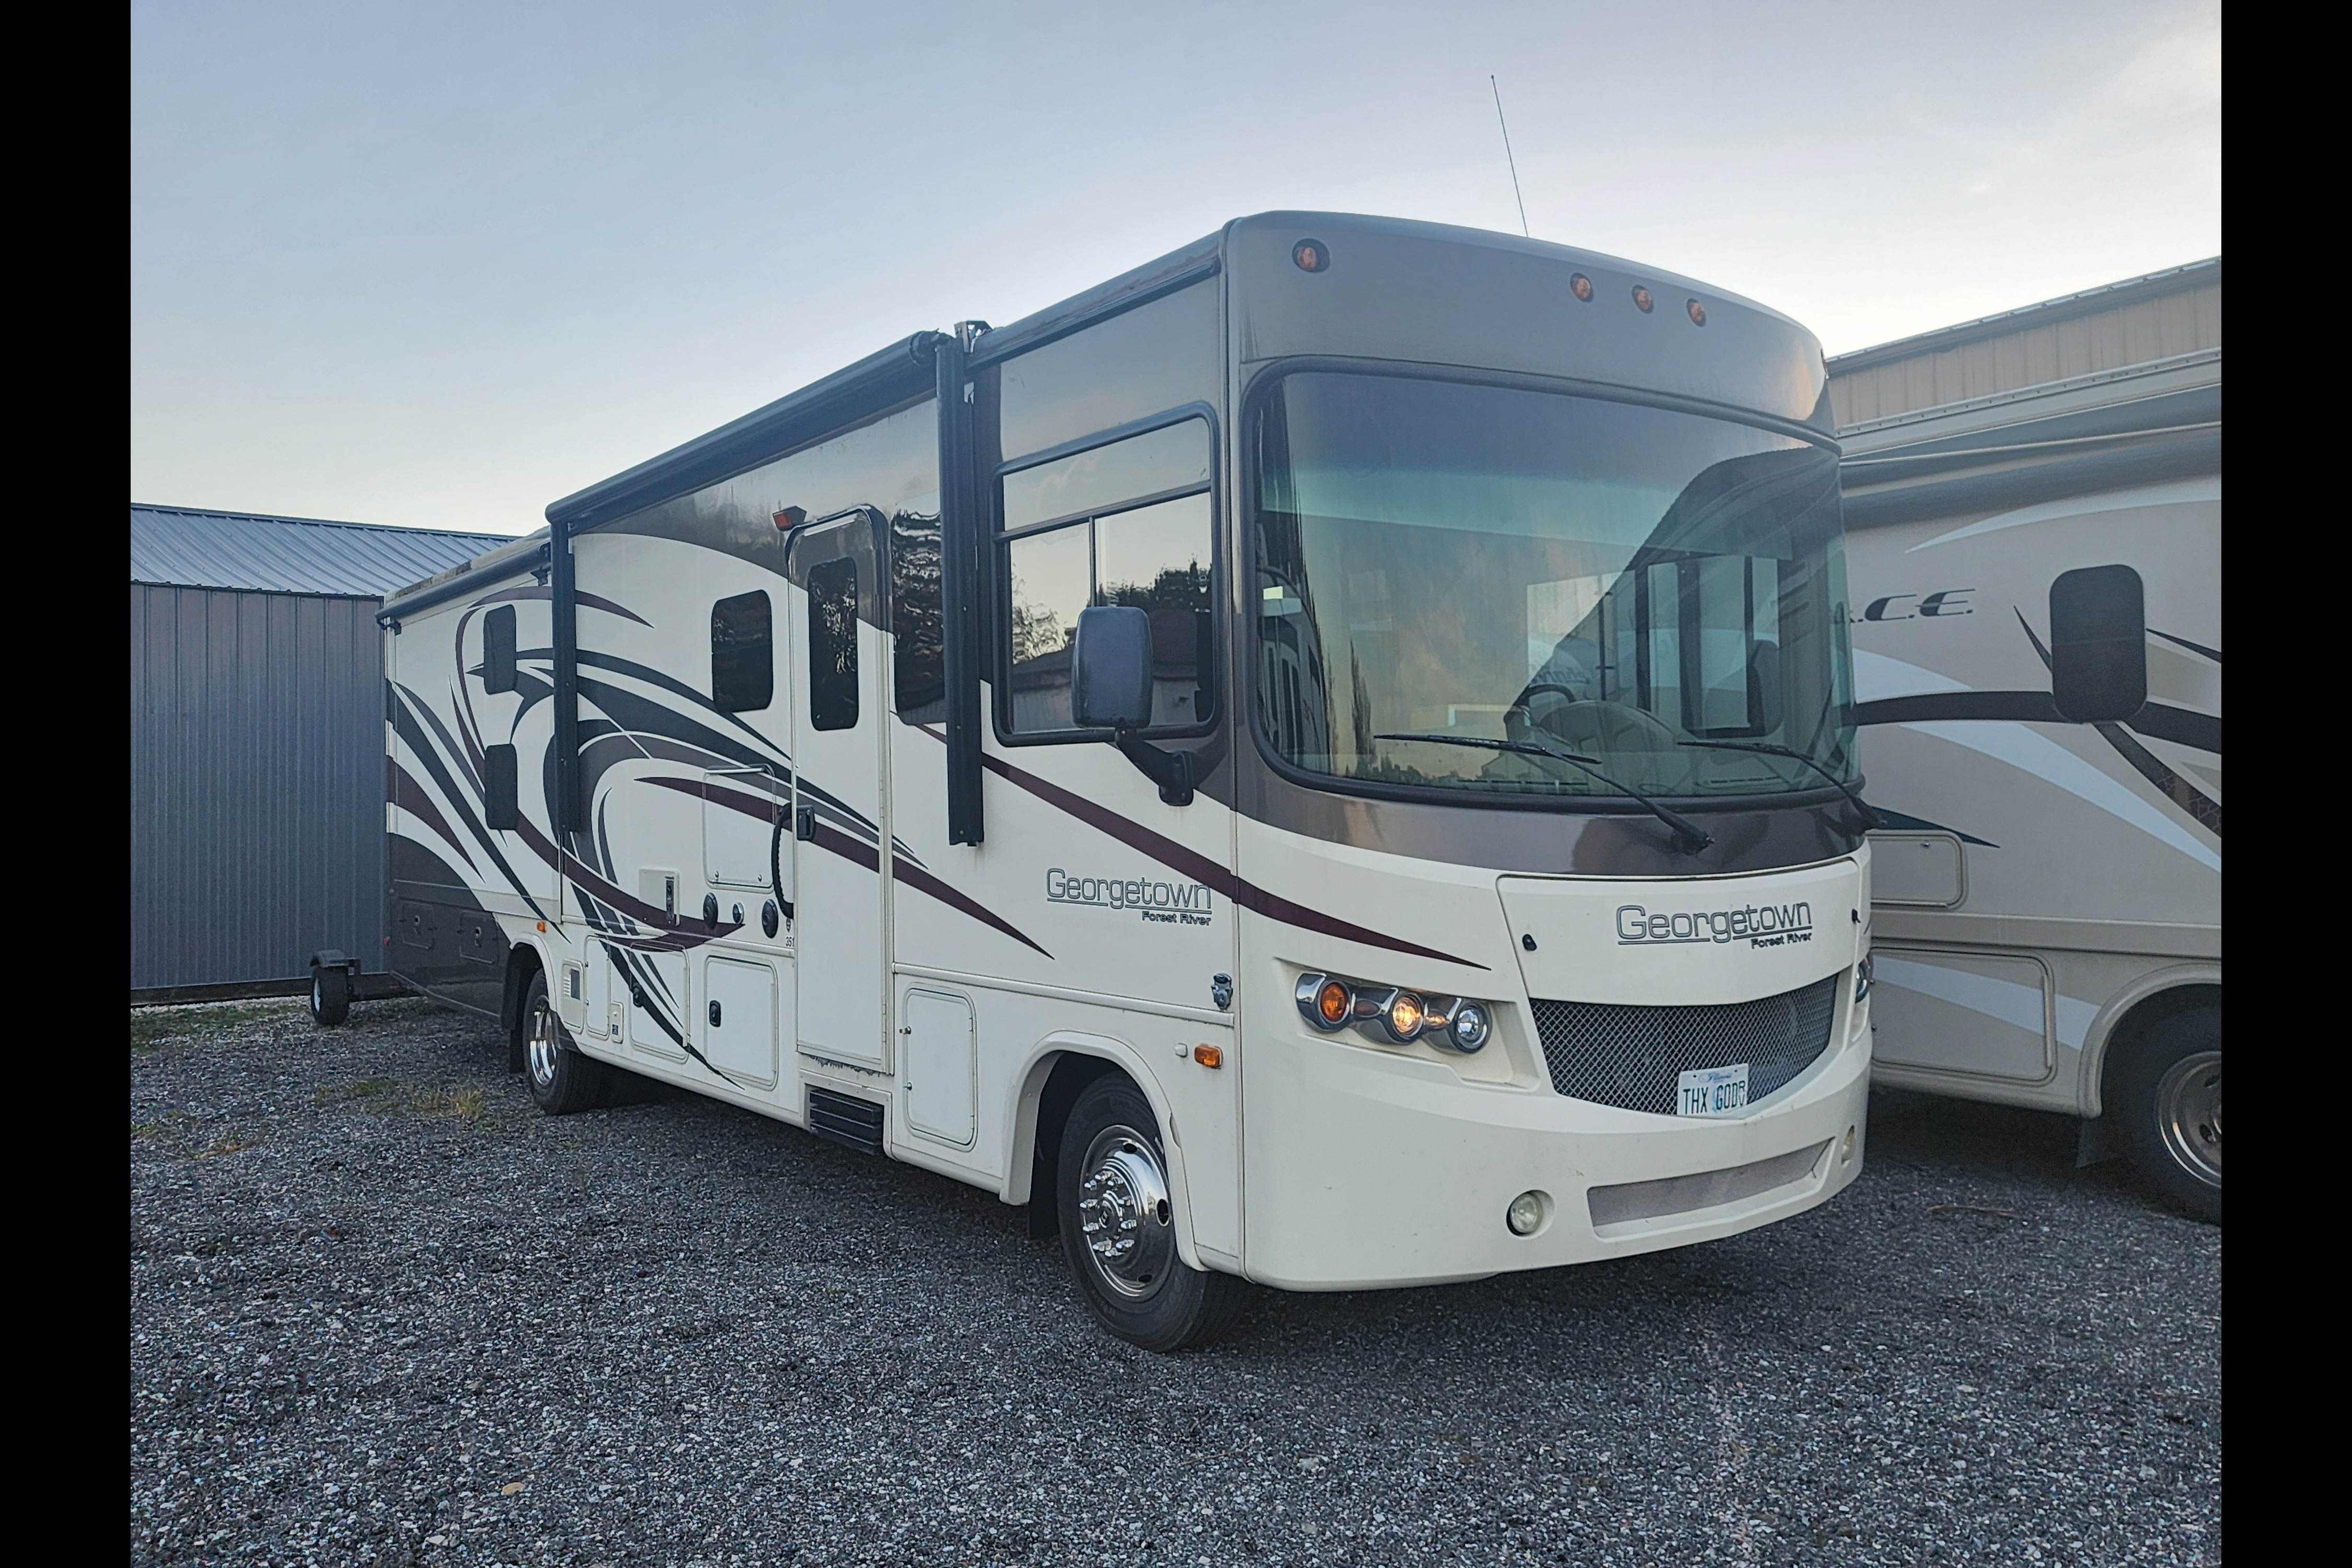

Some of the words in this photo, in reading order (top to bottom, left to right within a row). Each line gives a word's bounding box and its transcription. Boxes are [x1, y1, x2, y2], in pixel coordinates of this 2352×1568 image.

[1046, 868, 1212, 910] Georgetown
[1142, 911, 1178, 924] Forest
[1180, 913, 1212, 926] River
[1616, 901, 1812, 943] Georgetown
[1750, 937, 1785, 950] Forest
[1786, 931, 1813, 945] River
[1682, 1087, 1709, 1115] THX
